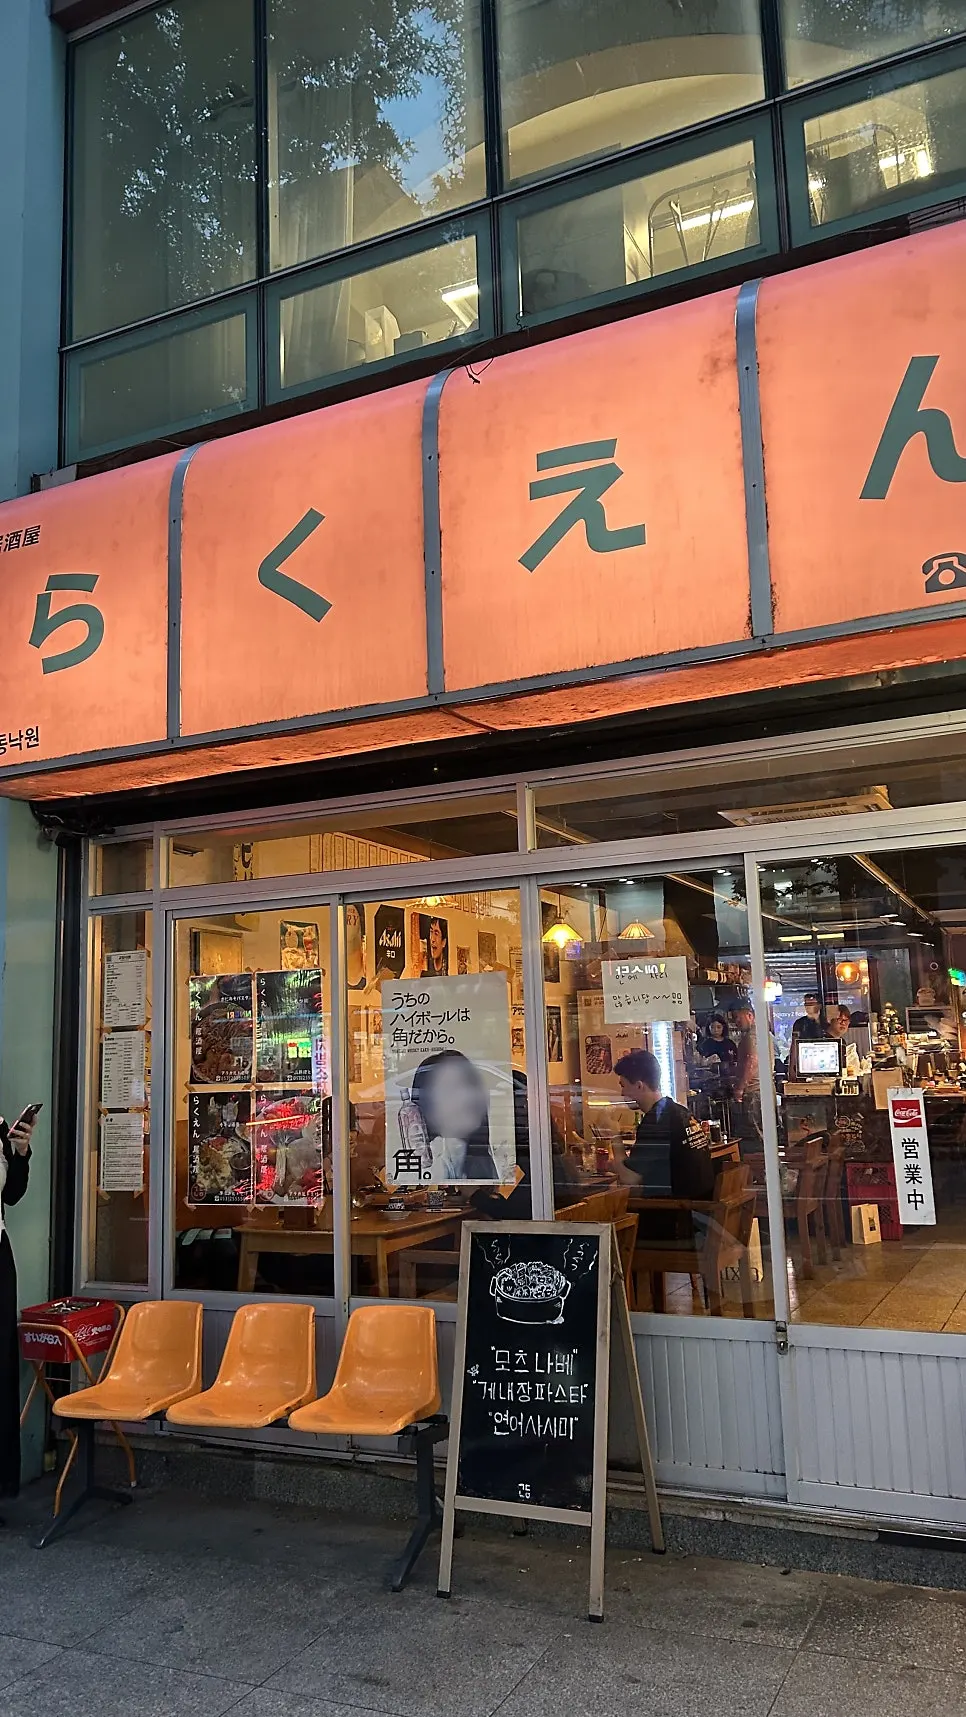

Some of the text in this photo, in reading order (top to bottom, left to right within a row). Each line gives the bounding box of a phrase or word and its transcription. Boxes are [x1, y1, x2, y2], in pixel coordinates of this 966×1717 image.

[0, 524, 41, 552] 酒屋
[379, 929, 402, 948] Asahi
[391, 992, 430, 1011] うちの
[389, 1007, 471, 1027] ハイボールは
[390, 1027, 455, 1048] 角だから。
[192, 1095, 201, 1139] らくえん
[392, 1149, 431, 1180] 角。
[901, 1137, 924, 1210] 営業中
